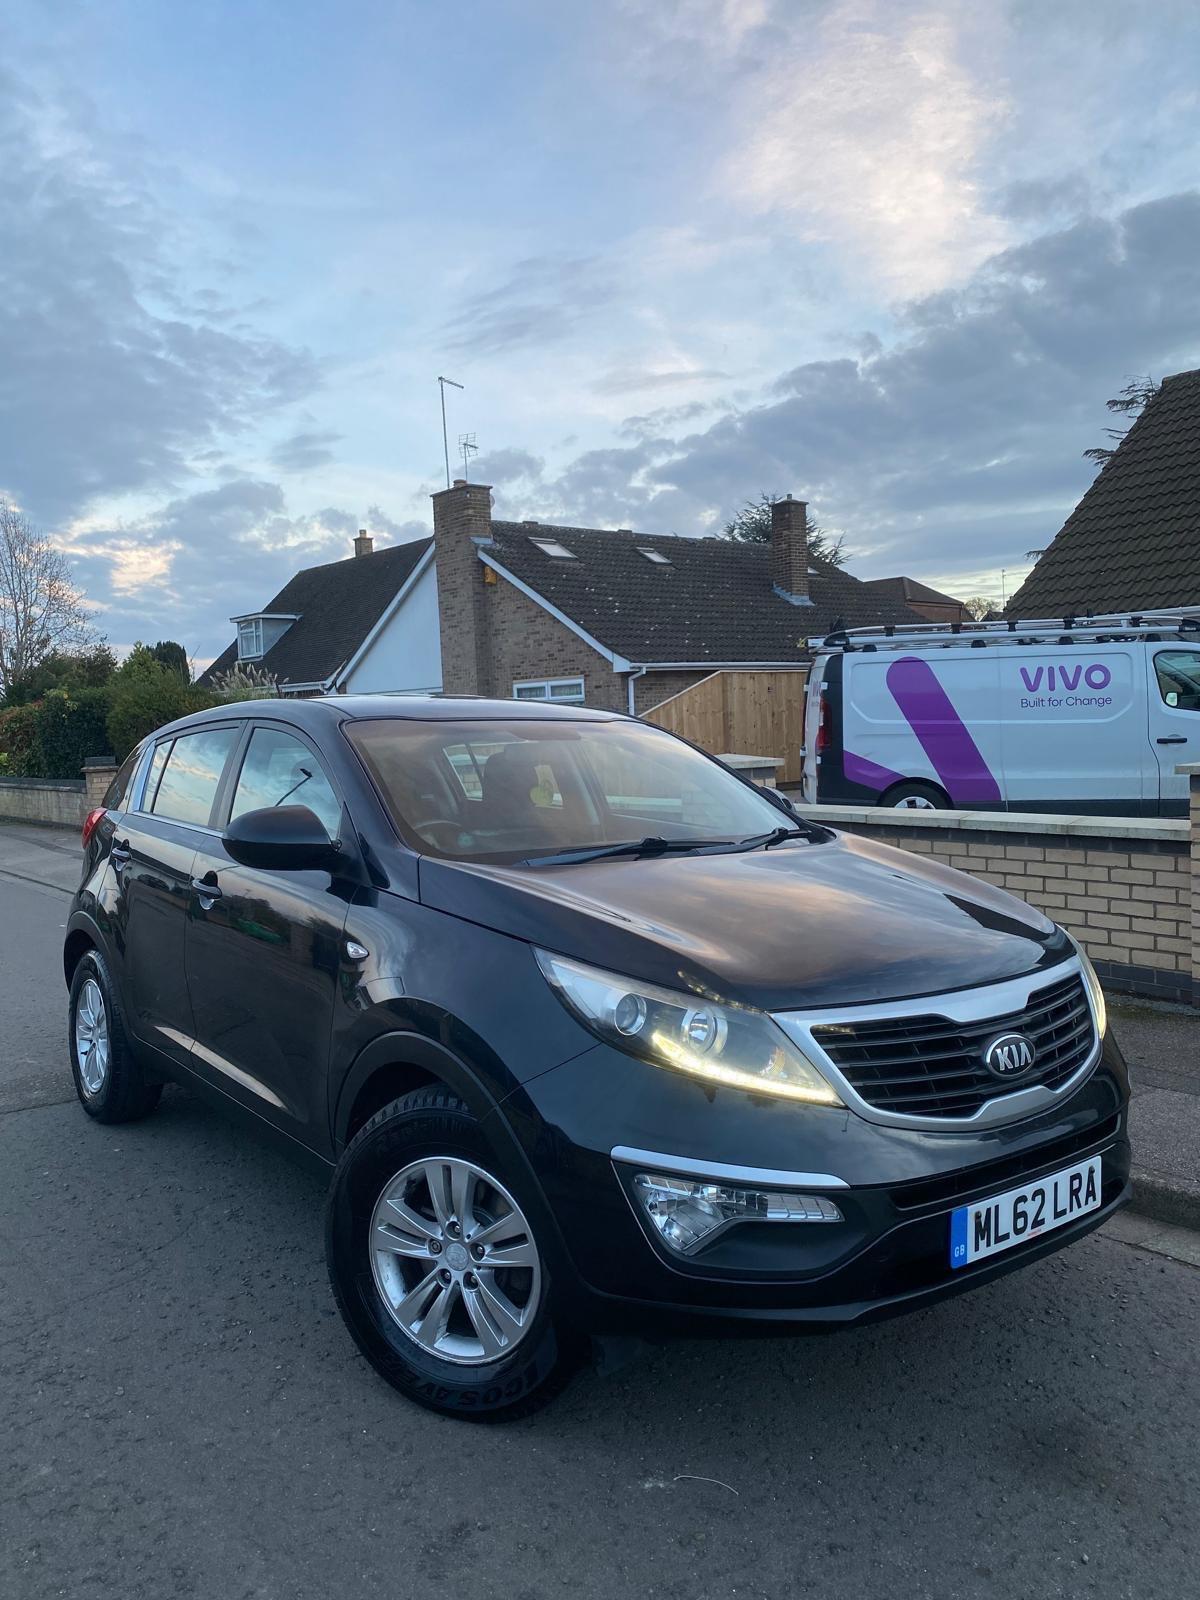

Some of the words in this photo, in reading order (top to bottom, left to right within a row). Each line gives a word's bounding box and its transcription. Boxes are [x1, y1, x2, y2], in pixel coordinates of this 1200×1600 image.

[1020, 664, 1111, 692] VIVO
[1021, 698, 1046, 708] Built
[1048, 697, 1064, 707] for
[1066, 696, 1112, 707] Change
[995, 1042, 1032, 1071] KIA
[974, 1188, 1046, 1252] ML62
[1053, 1166, 1097, 1221] LRA
[954, 1244, 965, 1257] GB
